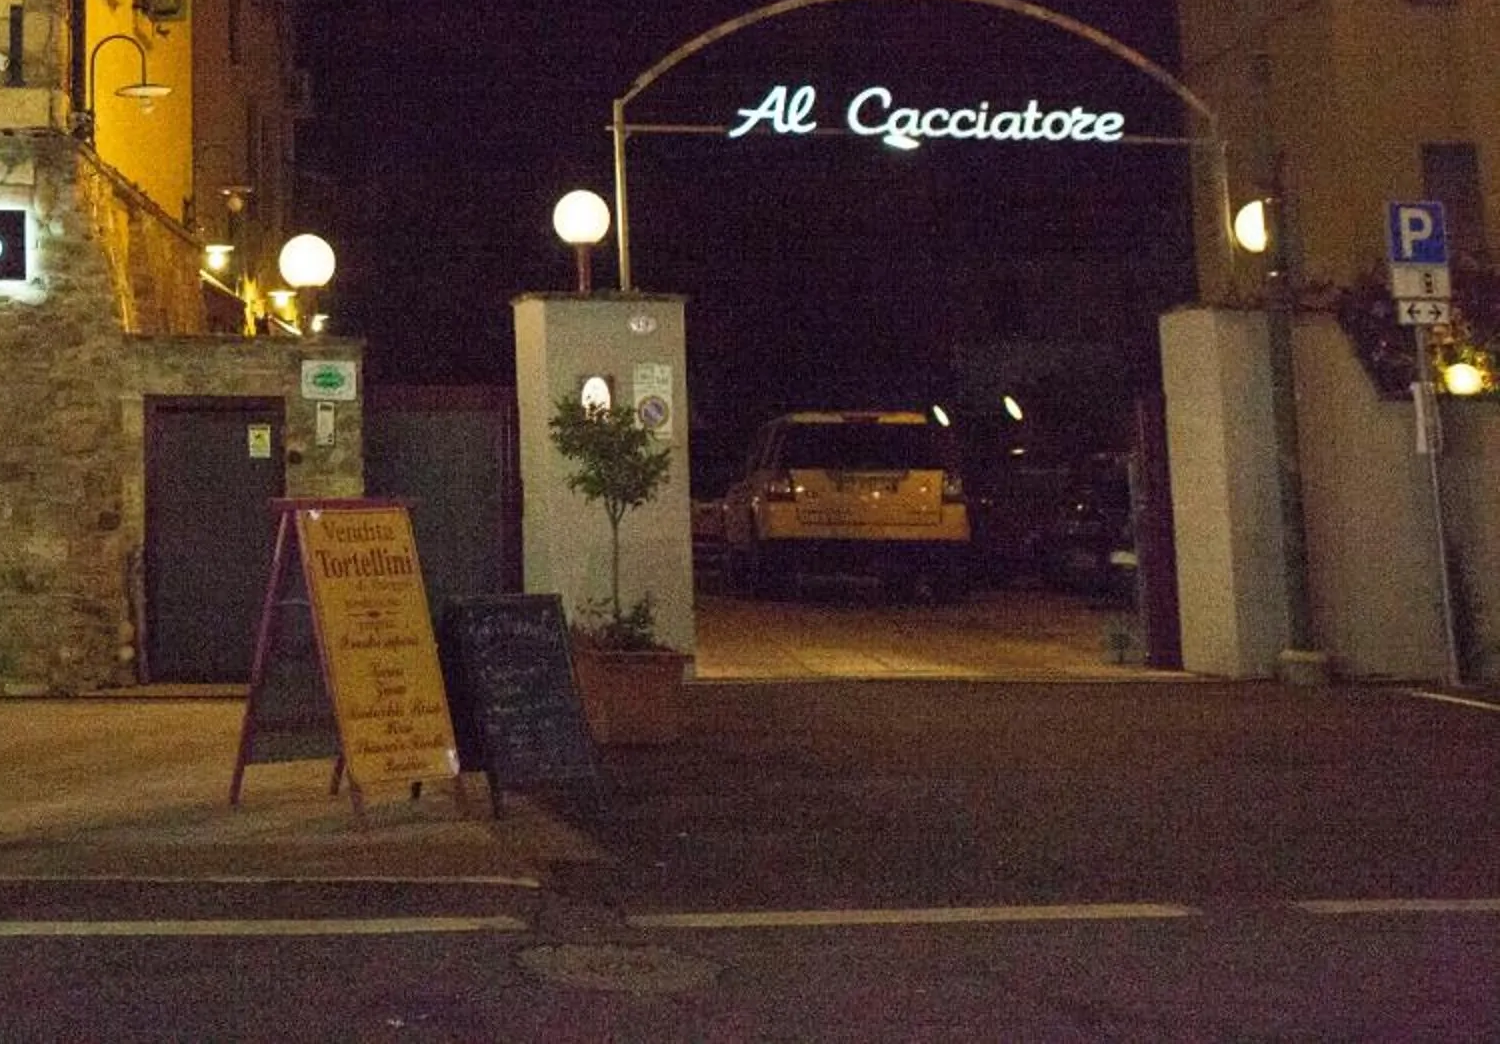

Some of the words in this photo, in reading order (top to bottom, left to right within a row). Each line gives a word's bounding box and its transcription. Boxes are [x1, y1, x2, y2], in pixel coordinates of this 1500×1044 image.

[729, 85, 817, 138] Al
[847, 87, 1125, 148] Cacciatore
[1400, 208, 1432, 258] P
[322, 521, 397, 542] Vendita
[315, 546, 414, 578] Tortellini
